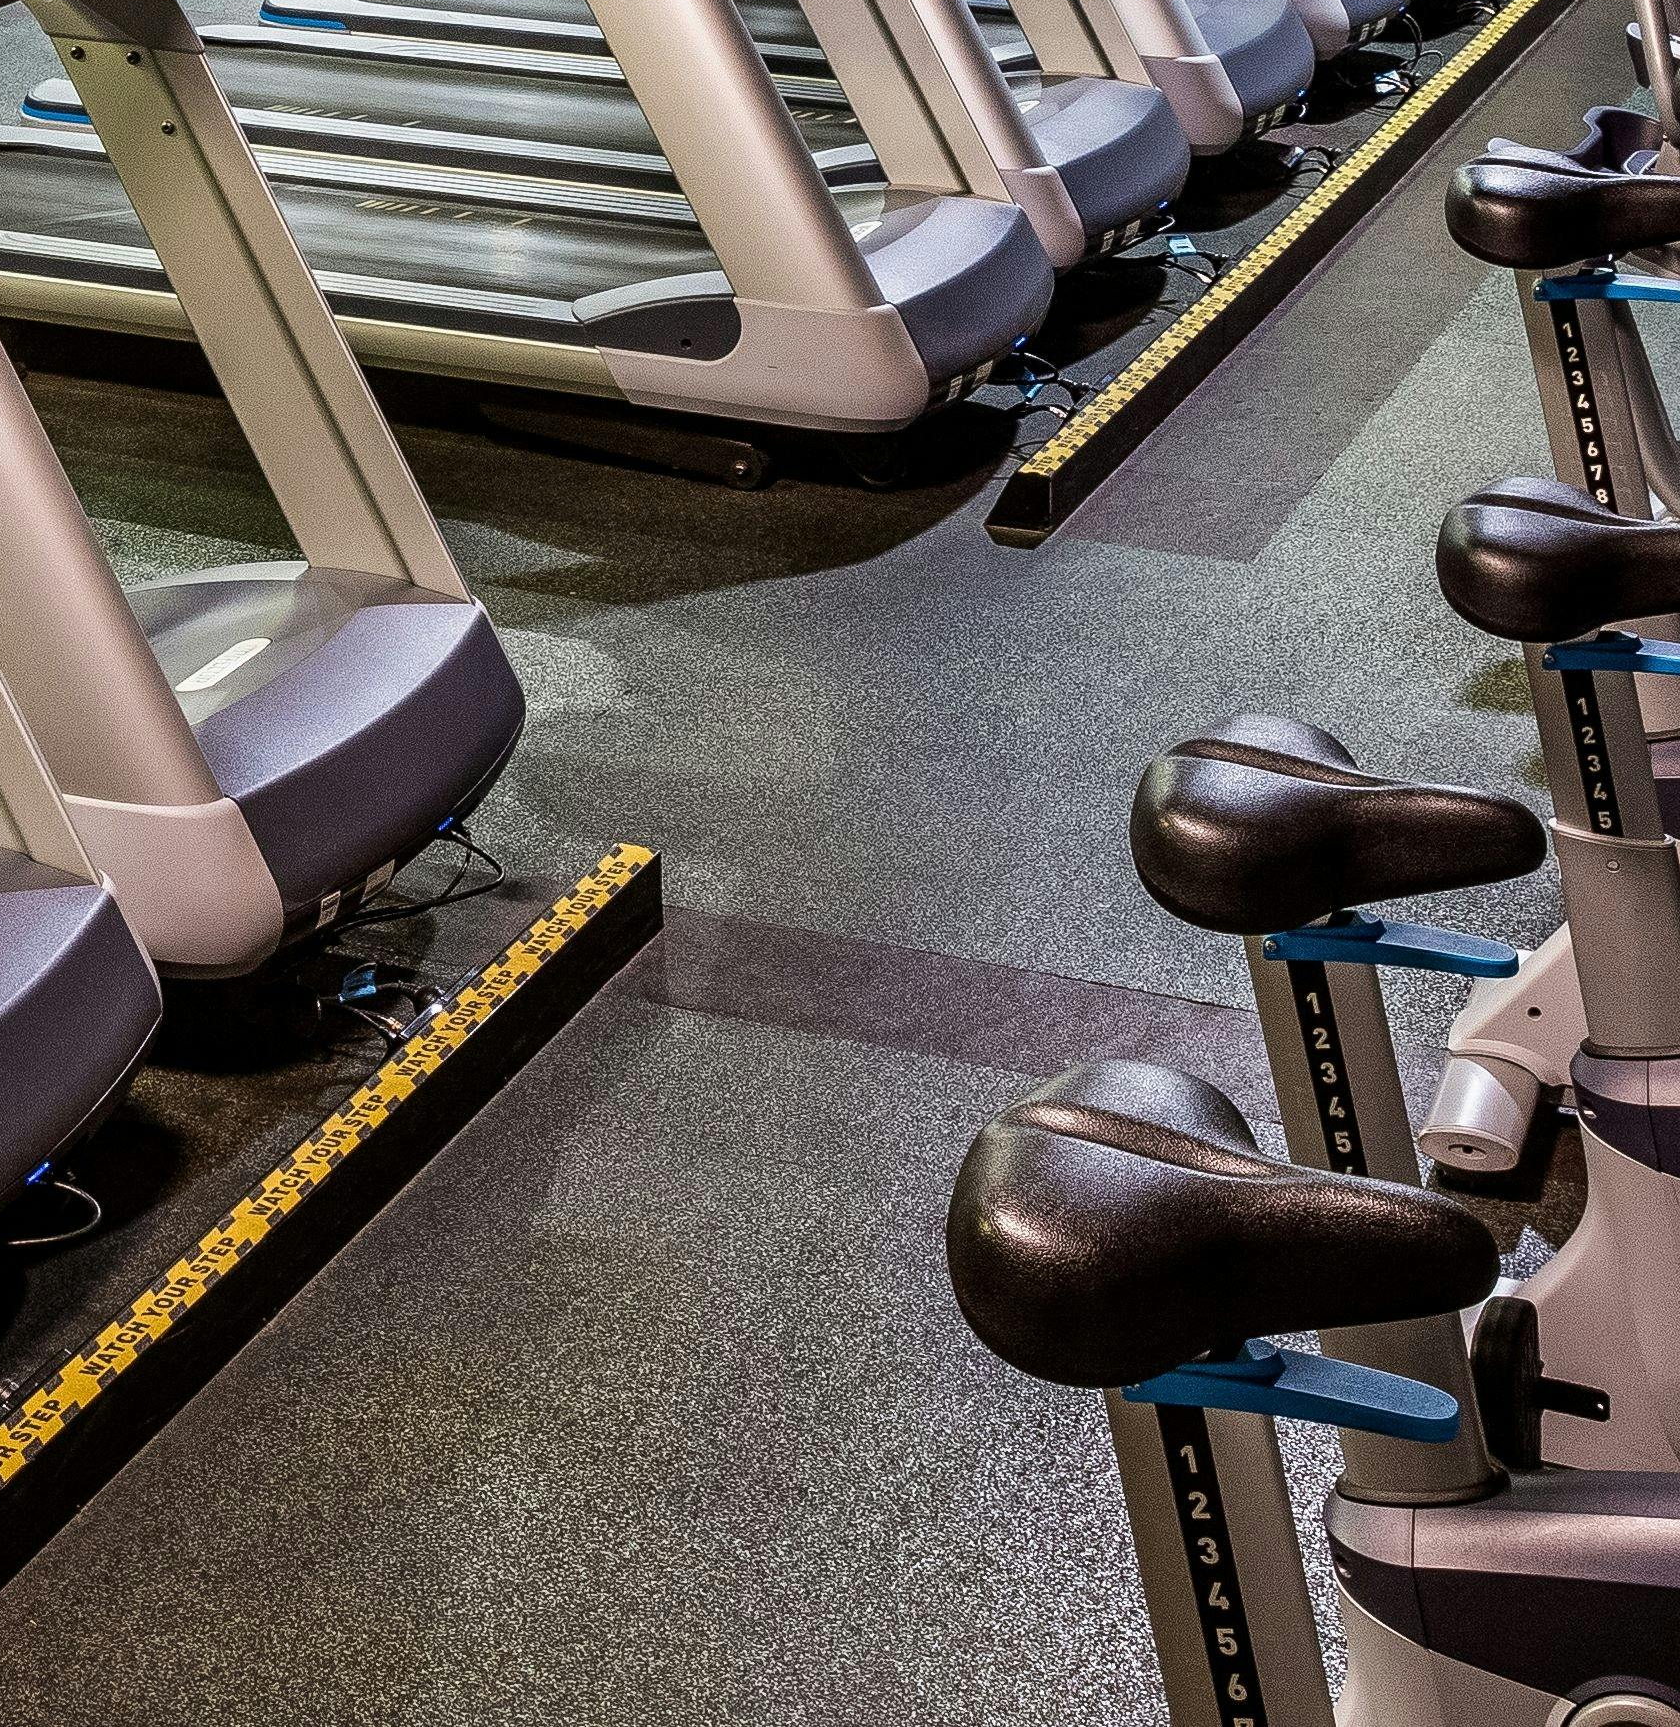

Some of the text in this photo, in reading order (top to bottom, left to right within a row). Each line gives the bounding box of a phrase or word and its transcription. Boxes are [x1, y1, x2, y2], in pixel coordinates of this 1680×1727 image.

[1562, 322, 1573, 338] 1
[1566, 346, 1580, 363] 2
[1571, 370, 1584, 386] 3
[1577, 393, 1590, 409] 4
[1580, 417, 1594, 433] 5
[1587, 441, 1599, 457] 6
[1590, 464, 1602, 481] 7
[1595, 488, 1609, 504] 8
[1576, 697, 1589, 716] 1
[1581, 726, 1596, 745] 2
[1587, 754, 1601, 772] 3
[1593, 782, 1608, 801] 4
[1597, 811, 1612, 829] 5
[522, 859, 630, 956] WATCH YOUR STEP
[1306, 992, 1321, 1015] 1
[394, 968, 516, 1078] WATCH YOUR STEP
[1312, 1027, 1331, 1050] 2
[1320, 1061, 1338, 1084] 3
[1328, 1096, 1346, 1119] 4
[1334, 1131, 1352, 1154] 5
[247, 1094, 386, 1218] WATCH YOUR STEP
[79, 1236, 239, 1378] WATCH YOUR STEP
[8, 1398, 64, 1448] STEP
[1180, 1444, 1198, 1474] 1
[1187, 1491, 1212, 1520] 2
[1197, 1536, 1220, 1565] 3
[1208, 1581, 1230, 1610] 4
[1215, 1627, 1238, 1656] 5
[1227, 1673, 1248, 1702] 6
